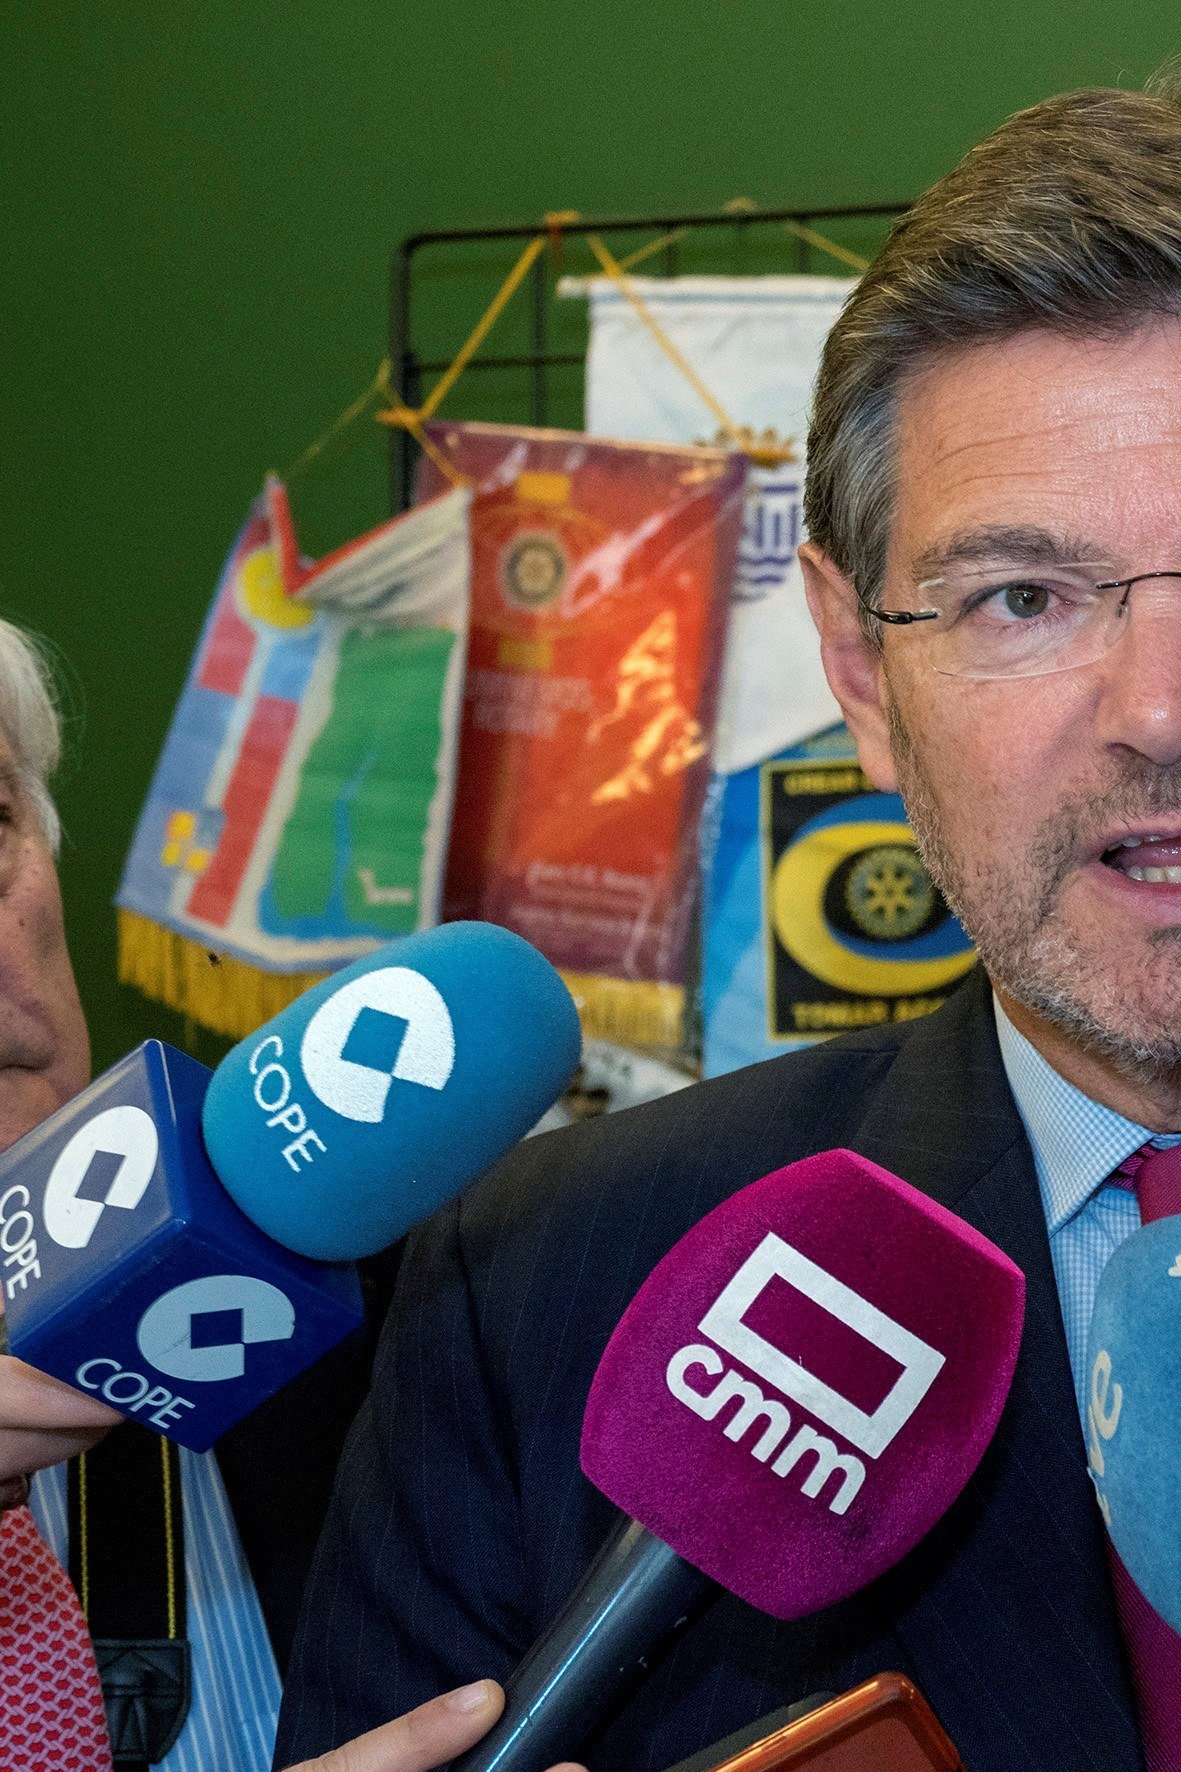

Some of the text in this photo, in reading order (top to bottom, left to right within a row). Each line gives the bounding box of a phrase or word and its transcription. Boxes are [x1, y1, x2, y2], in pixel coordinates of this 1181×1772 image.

[249, 1035, 327, 1172] COPE
[0, 1184, 42, 1301] COPE
[76, 1357, 196, 1429] COPE
[666, 1343, 867, 1516] cmm
